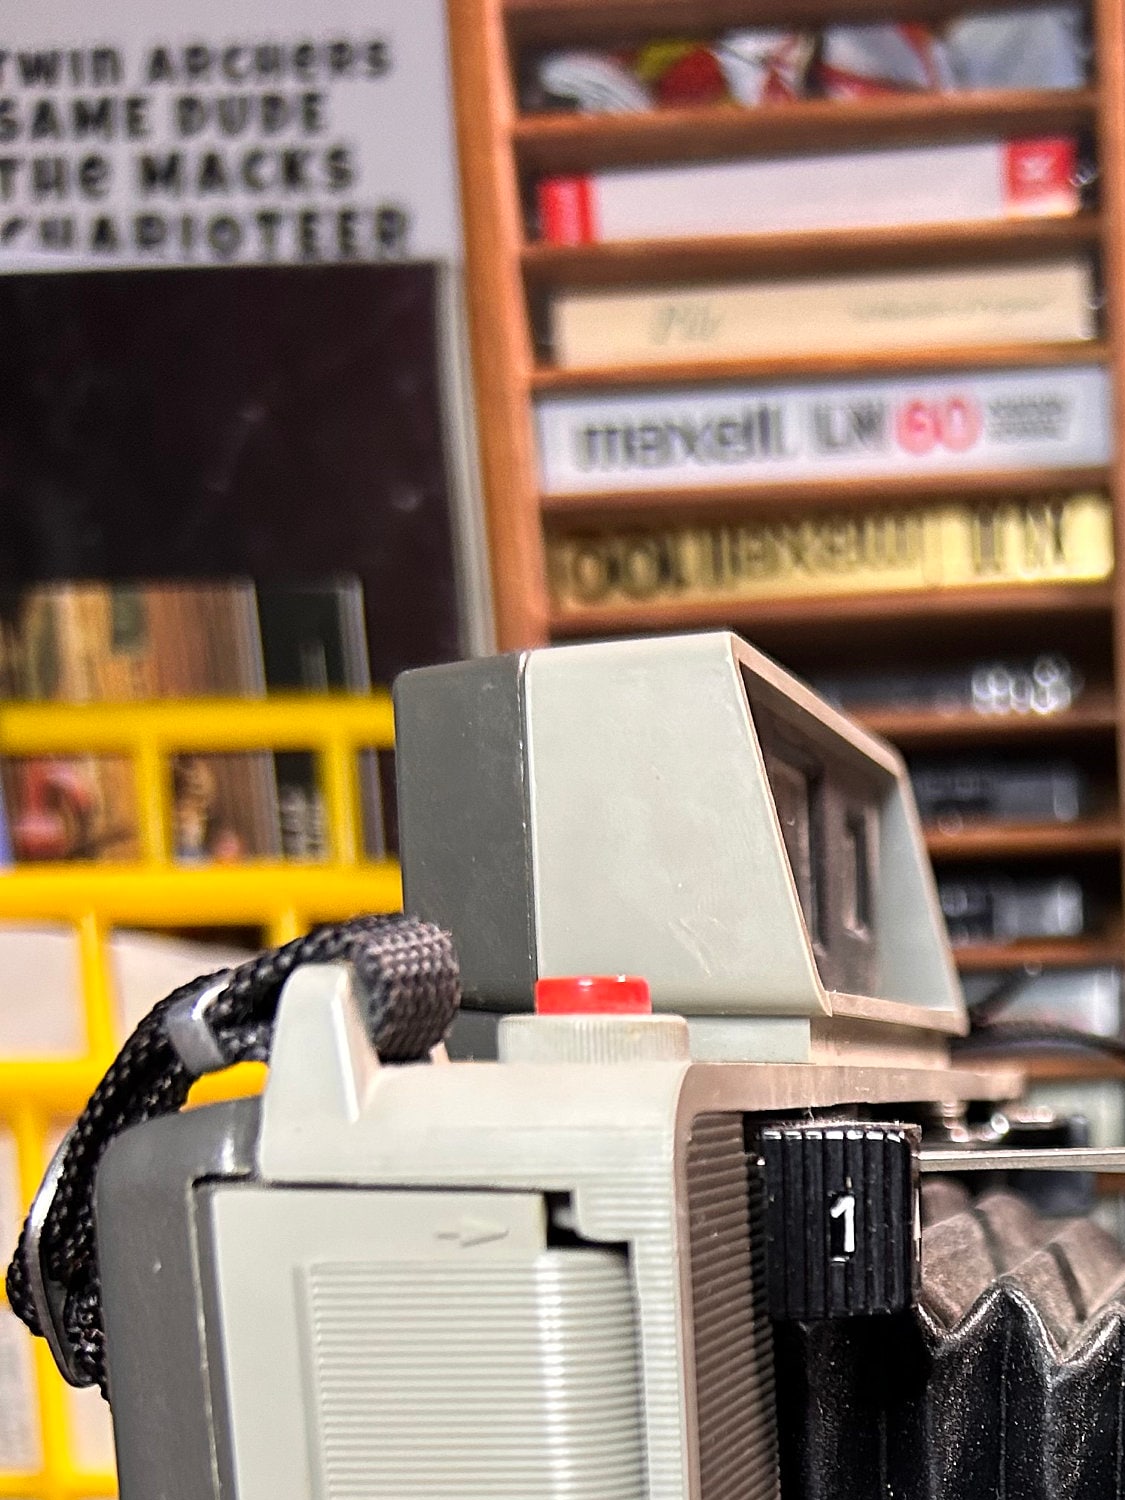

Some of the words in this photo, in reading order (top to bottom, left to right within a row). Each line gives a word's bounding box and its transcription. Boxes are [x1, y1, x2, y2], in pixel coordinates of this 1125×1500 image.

[0, 47, 122, 86] WIN
[139, 145, 358, 195] MACKS
[577, 401, 787, 472] maxell
[829, 1195, 856, 1253] 1
